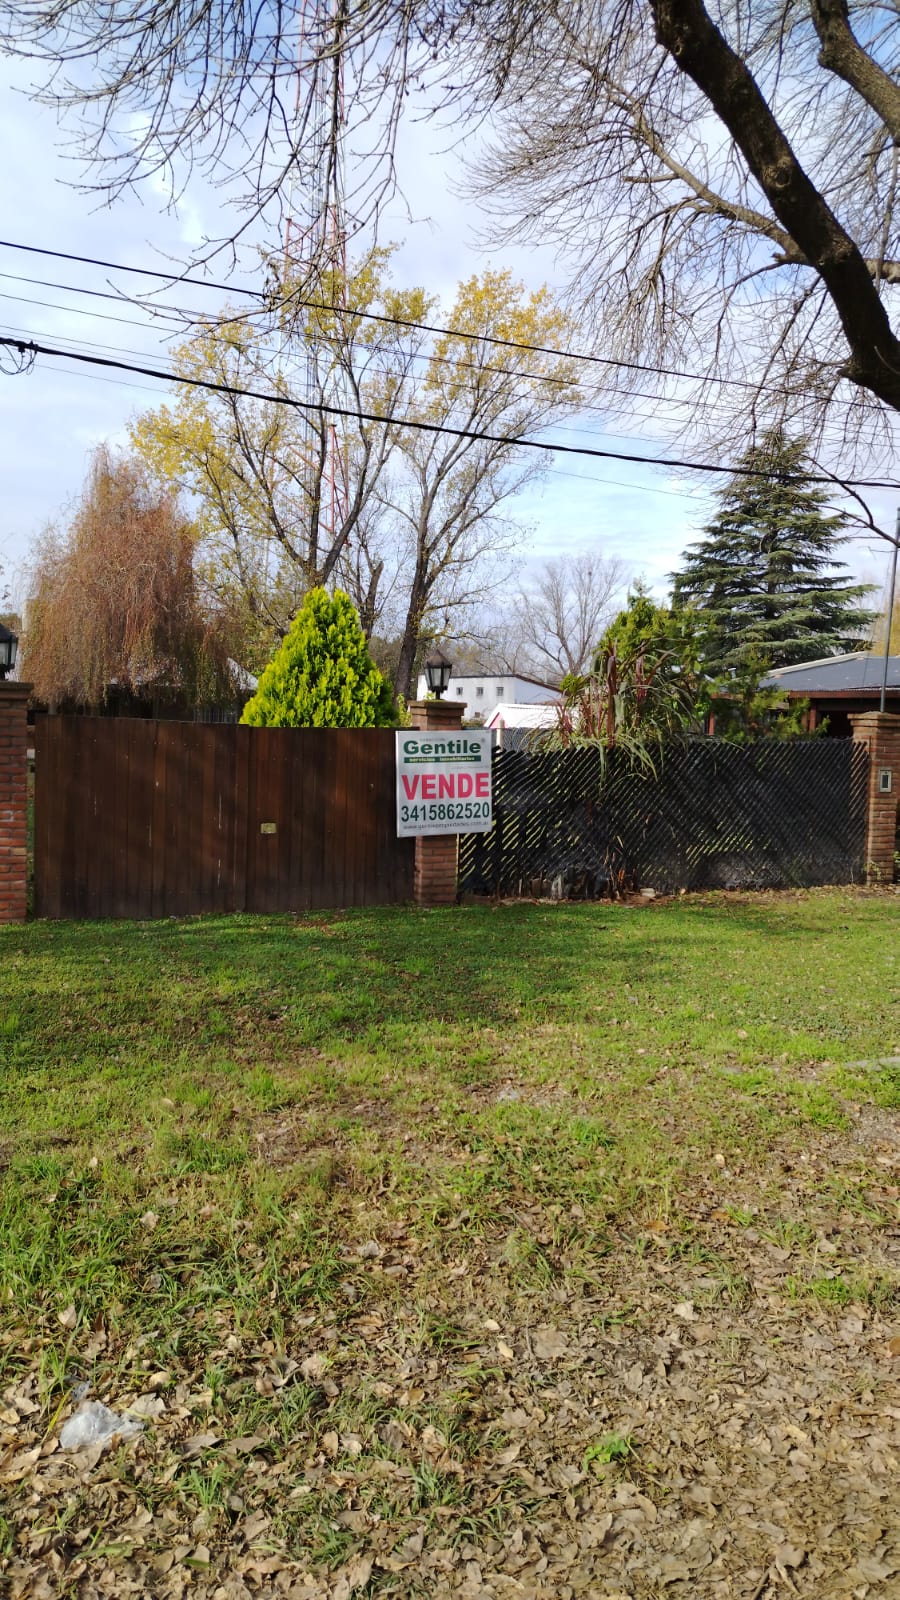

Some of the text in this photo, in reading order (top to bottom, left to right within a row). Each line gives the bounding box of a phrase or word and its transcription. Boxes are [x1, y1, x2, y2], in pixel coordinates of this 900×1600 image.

[403, 739, 482, 755] Gentile
[401, 772, 490, 801] VENDE
[401, 802, 490, 822] 3415862520
